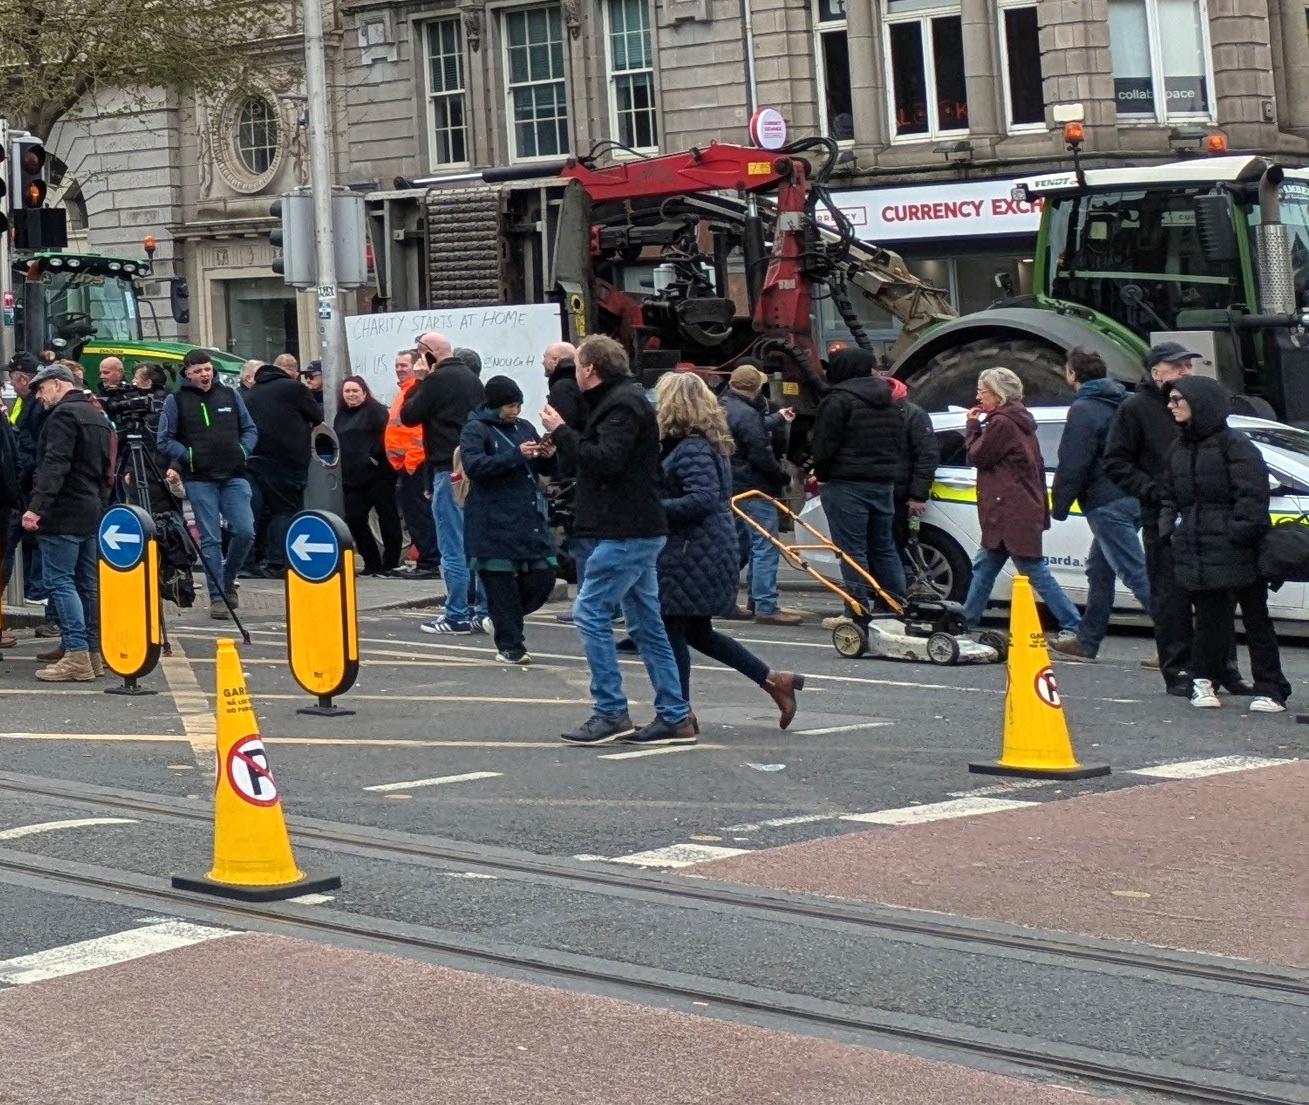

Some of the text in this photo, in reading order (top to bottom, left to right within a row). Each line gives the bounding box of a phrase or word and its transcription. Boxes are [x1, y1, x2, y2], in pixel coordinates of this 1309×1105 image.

[881, 197, 1044, 223] CURRENCY EXCH
[353, 310, 527, 340] CHARITY STARTS AT HOME
[483, 355, 536, 370] ENOUGH
[223, 686, 248, 698] GAR
